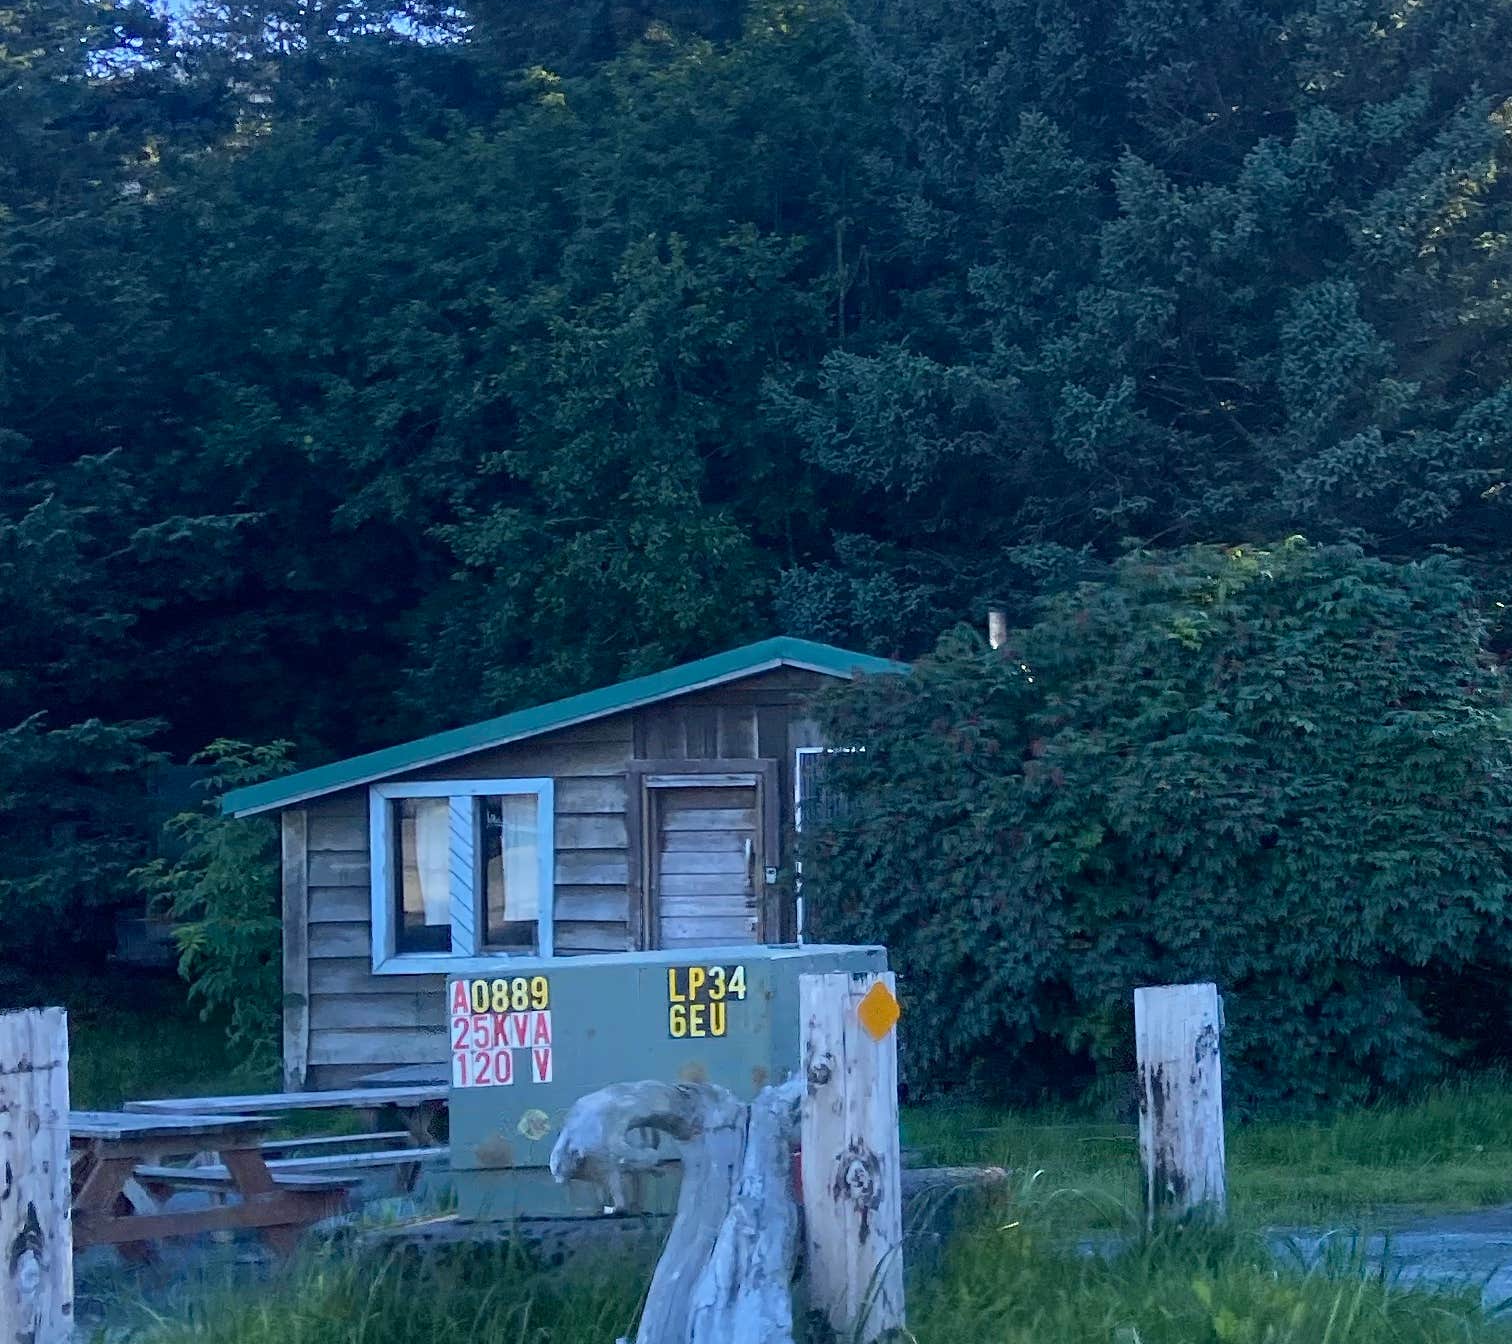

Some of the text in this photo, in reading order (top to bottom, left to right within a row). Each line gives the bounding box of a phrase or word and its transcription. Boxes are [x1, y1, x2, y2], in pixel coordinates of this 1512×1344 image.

[453, 976, 548, 1014] A0889
[669, 965, 746, 1002] LP34
[453, 1012, 550, 1049] 25KVA
[669, 1002, 725, 1037] 6EU
[457, 1048, 550, 1085] 120 V
